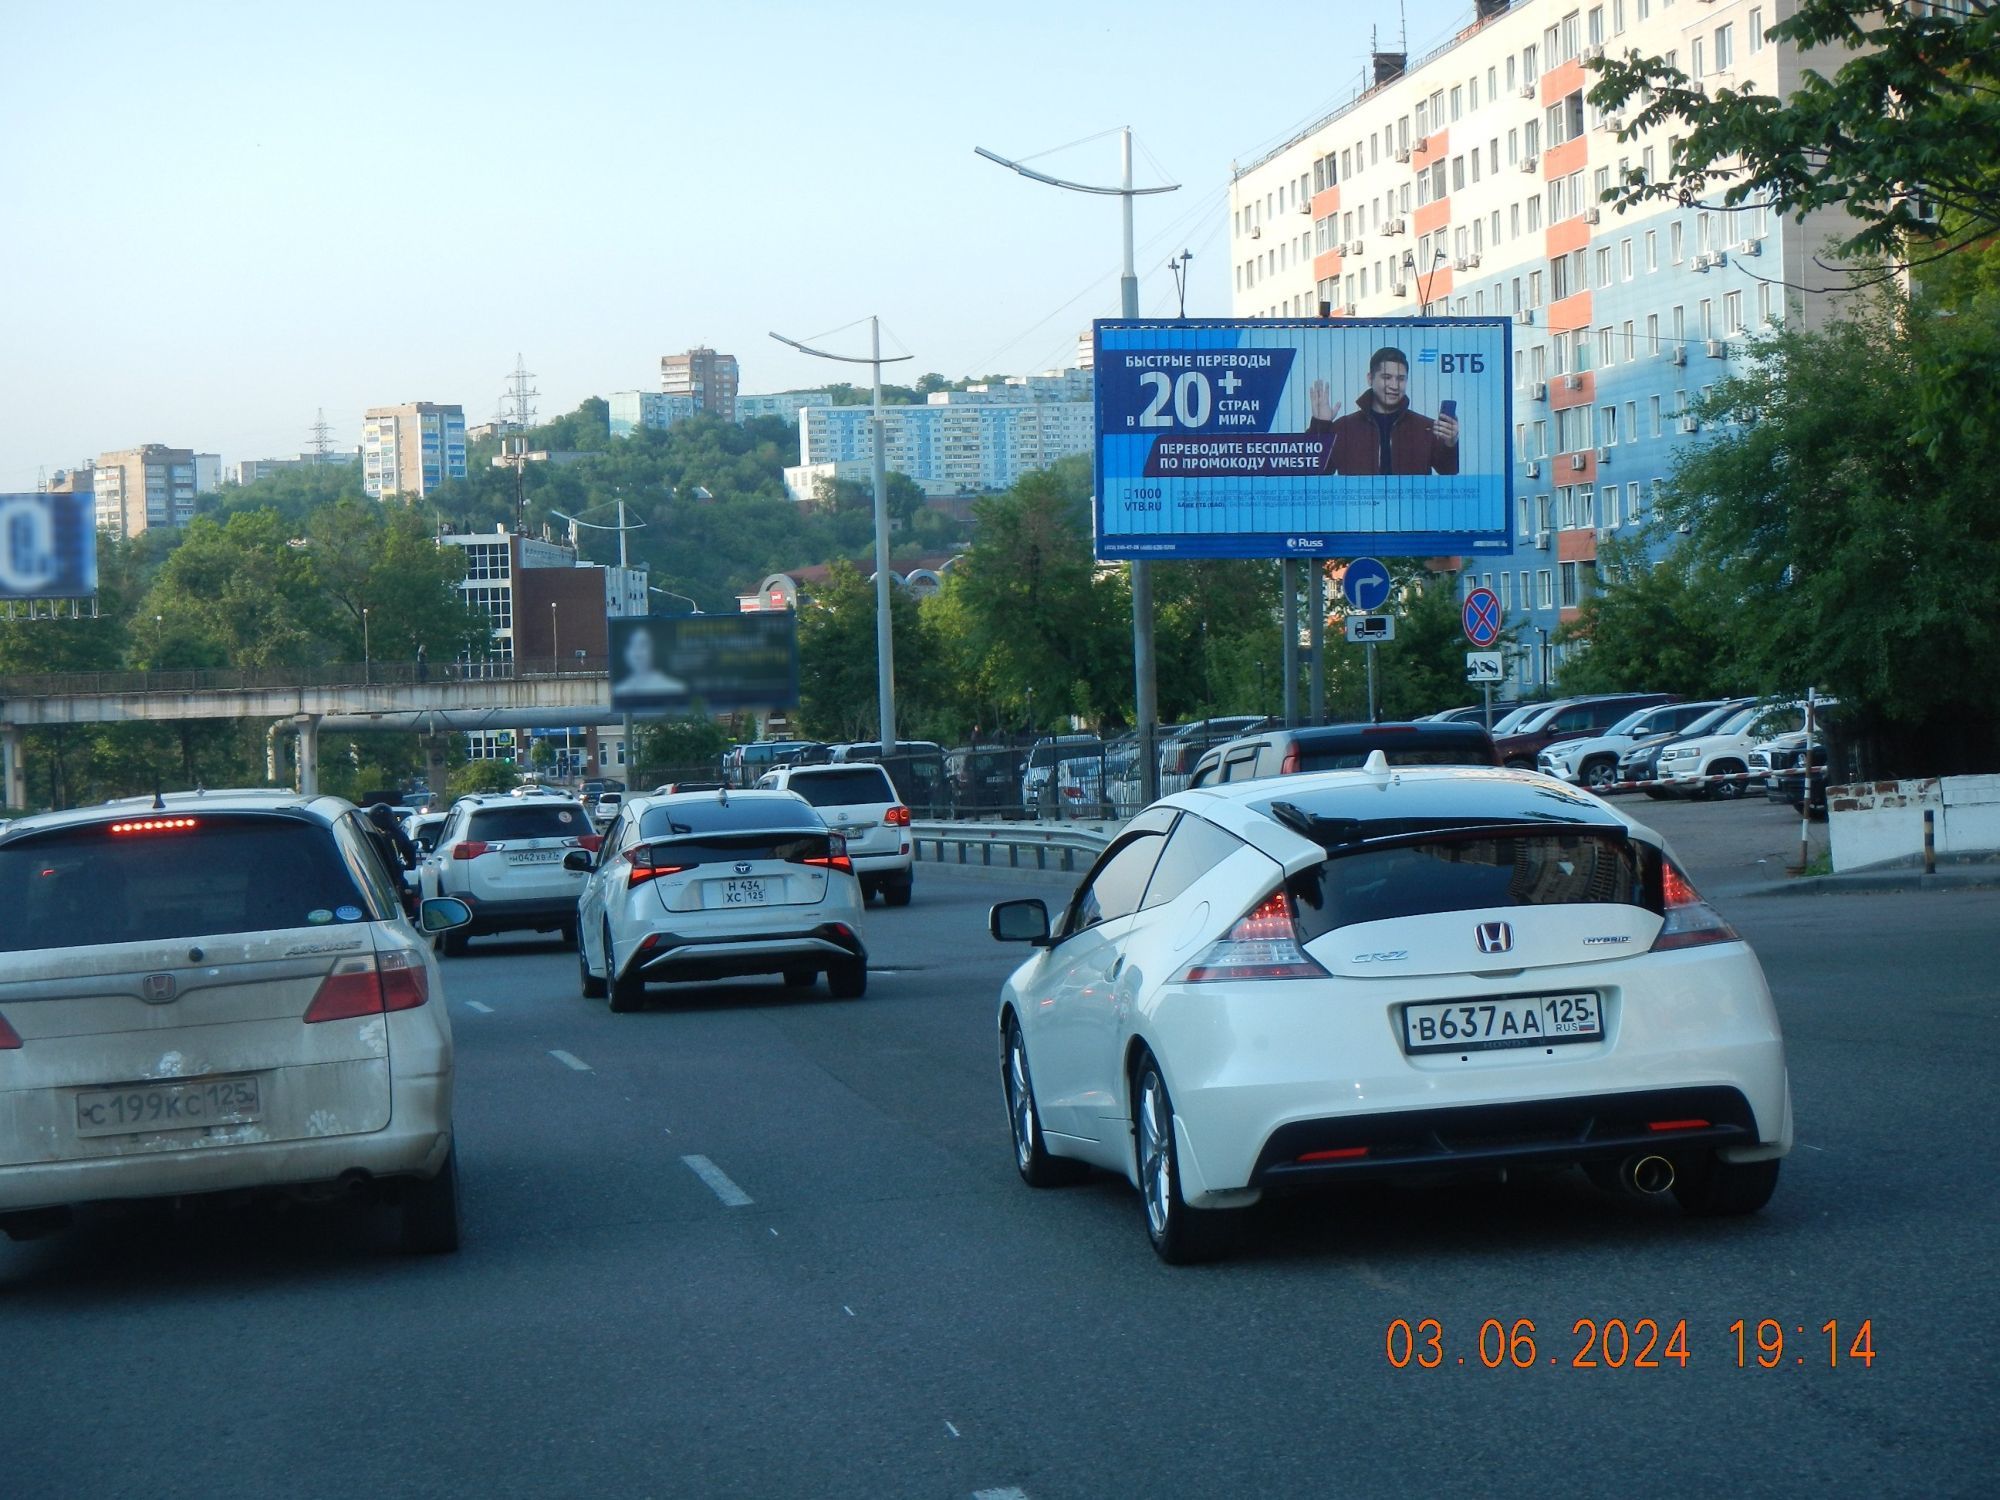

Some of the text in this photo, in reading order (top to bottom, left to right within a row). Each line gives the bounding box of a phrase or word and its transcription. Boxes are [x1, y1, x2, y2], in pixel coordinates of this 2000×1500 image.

[1125, 354, 1271, 369] БЫСТРЫЕ ПЕРЕВОДЫ
[1441, 353, 1485, 374] ВТБ
[1218, 400, 1260, 411] СТРАН
[1218, 414, 1256, 425] МИРА
[1160, 442, 1323, 456] ПЕРЕВОДИТЕ БЕСПЛАТНО
[1160, 456, 1320, 471] ПО ПРОМОКОДУ VMESTE
[1133, 488, 1162, 499] 1000
[1124, 501, 1162, 511] VTB.RU
[740, 880, 760, 891] 434
[747, 891, 764, 900] 125
[1585, 936, 1630, 944] HYBRID
[1545, 997, 1589, 1023] 125
[1555, 1022, 1578, 1032] RUS
[206, 1082, 248, 1106] 125
